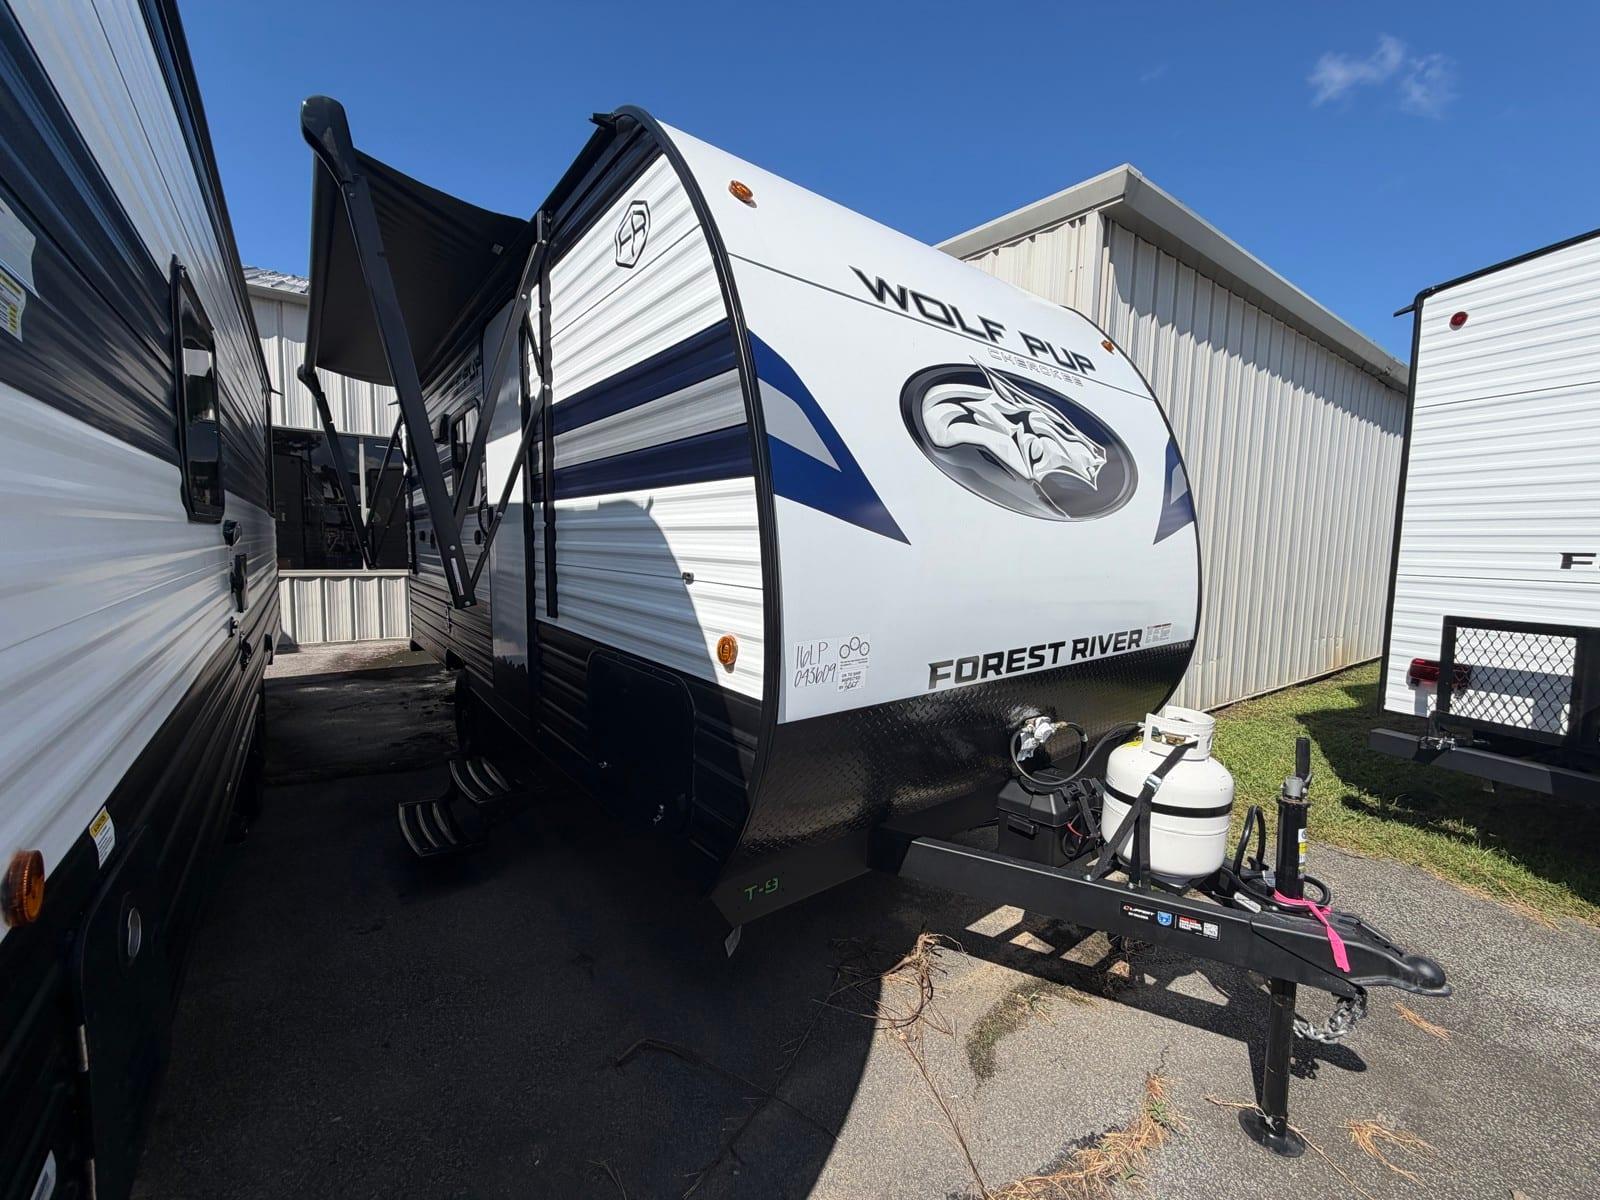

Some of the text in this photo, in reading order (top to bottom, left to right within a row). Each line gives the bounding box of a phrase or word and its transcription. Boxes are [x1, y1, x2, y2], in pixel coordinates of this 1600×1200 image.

[848, 265, 1097, 375] WOLF PUP
[988, 348, 1083, 387] CHEROKEE
[928, 640, 1066, 690] FOREST
[1070, 628, 1143, 661] RIVER
